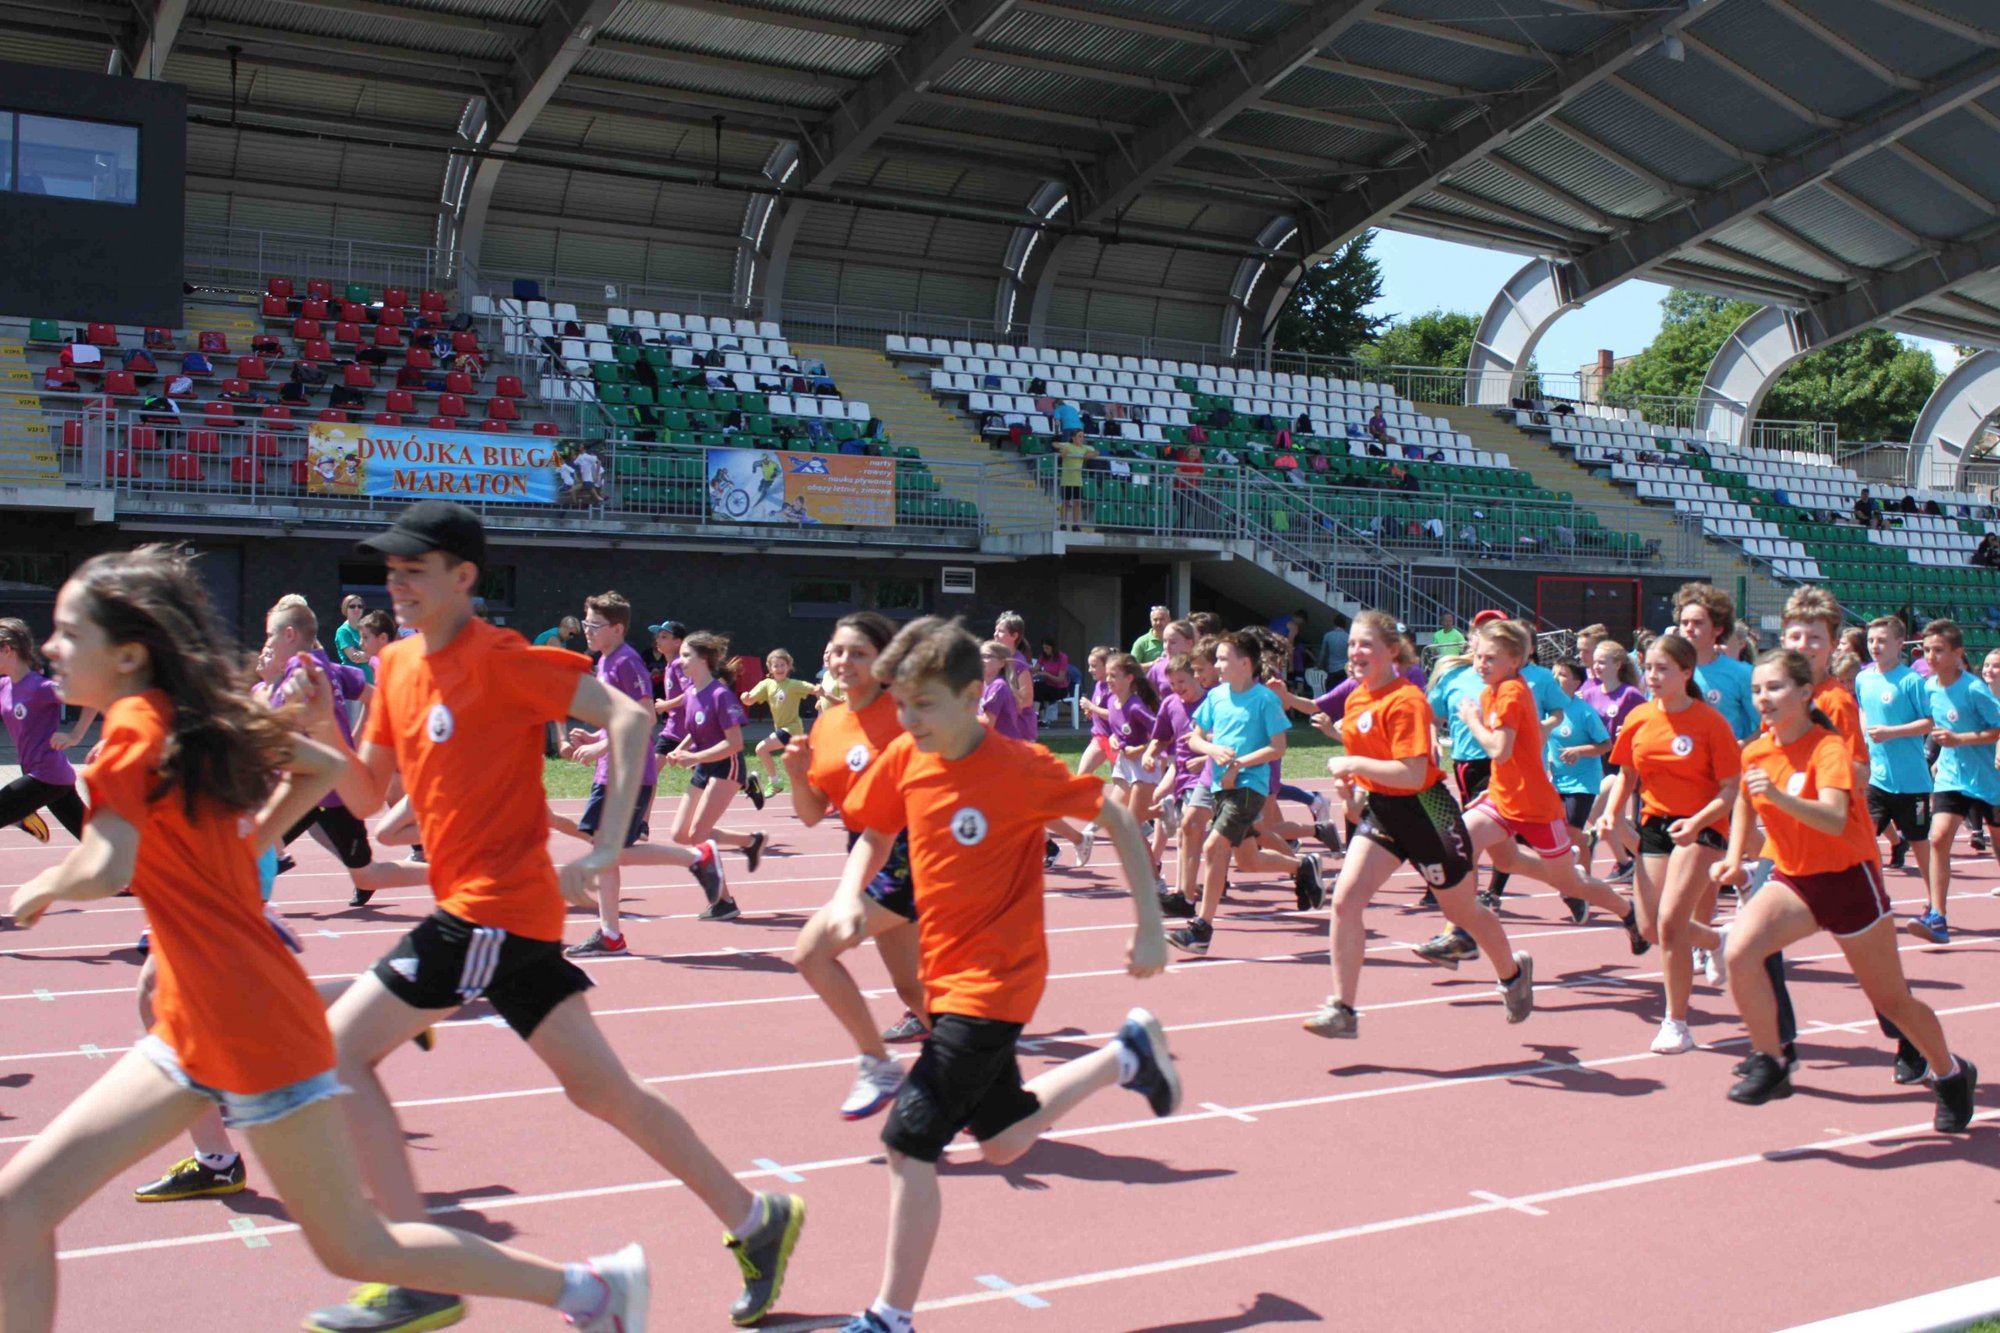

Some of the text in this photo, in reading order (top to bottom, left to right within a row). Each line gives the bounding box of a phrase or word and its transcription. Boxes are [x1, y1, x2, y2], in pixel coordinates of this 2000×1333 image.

[356, 435, 562, 468] DWÓJKA BIEGA
[392, 469, 528, 495] MARATON
